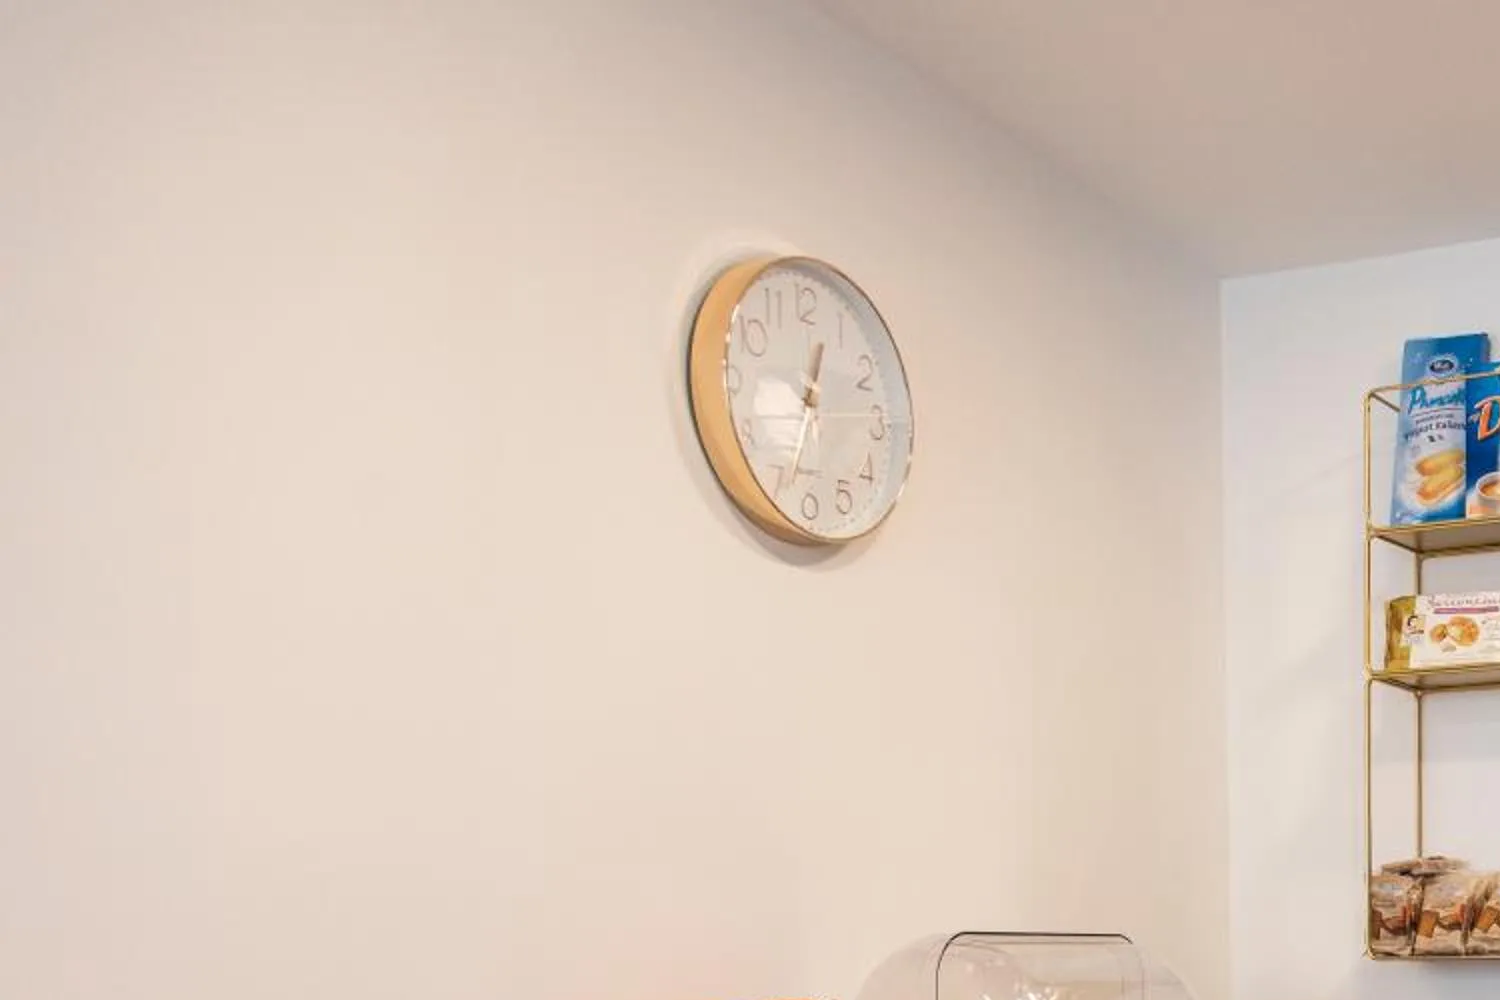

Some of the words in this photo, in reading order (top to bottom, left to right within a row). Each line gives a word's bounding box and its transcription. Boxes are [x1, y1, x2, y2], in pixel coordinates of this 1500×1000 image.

[765, 287, 783, 329] 11
[794, 281, 817, 325] 12
[740, 315, 768, 357] 10
[856, 354, 874, 392] 2
[868, 404, 886, 441] 3
[766, 464, 785, 499] 7
[859, 452, 874, 485] 4
[836, 479, 853, 515] 5
